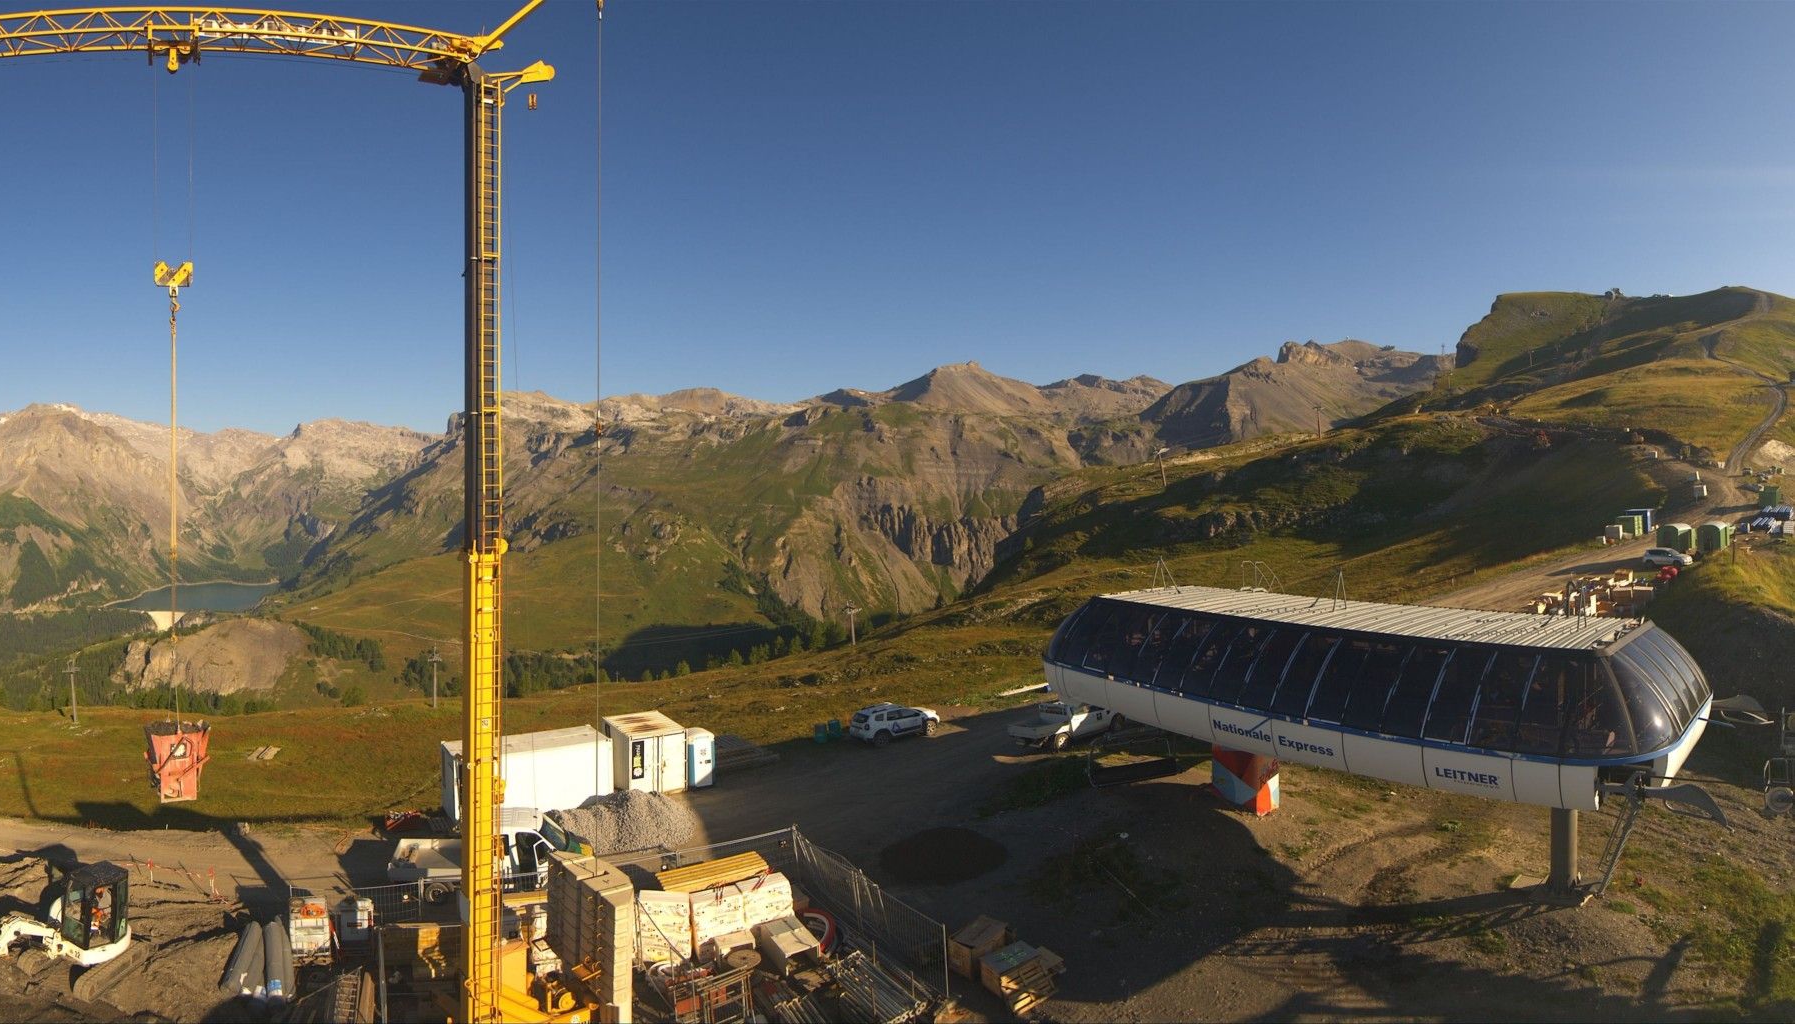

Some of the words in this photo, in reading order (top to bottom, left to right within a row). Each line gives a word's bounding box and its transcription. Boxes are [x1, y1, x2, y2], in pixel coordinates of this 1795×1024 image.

[1212, 719, 1271, 742] Nationale
[1278, 735, 1334, 756] Express
[1435, 767, 1498, 785] LEITNER
